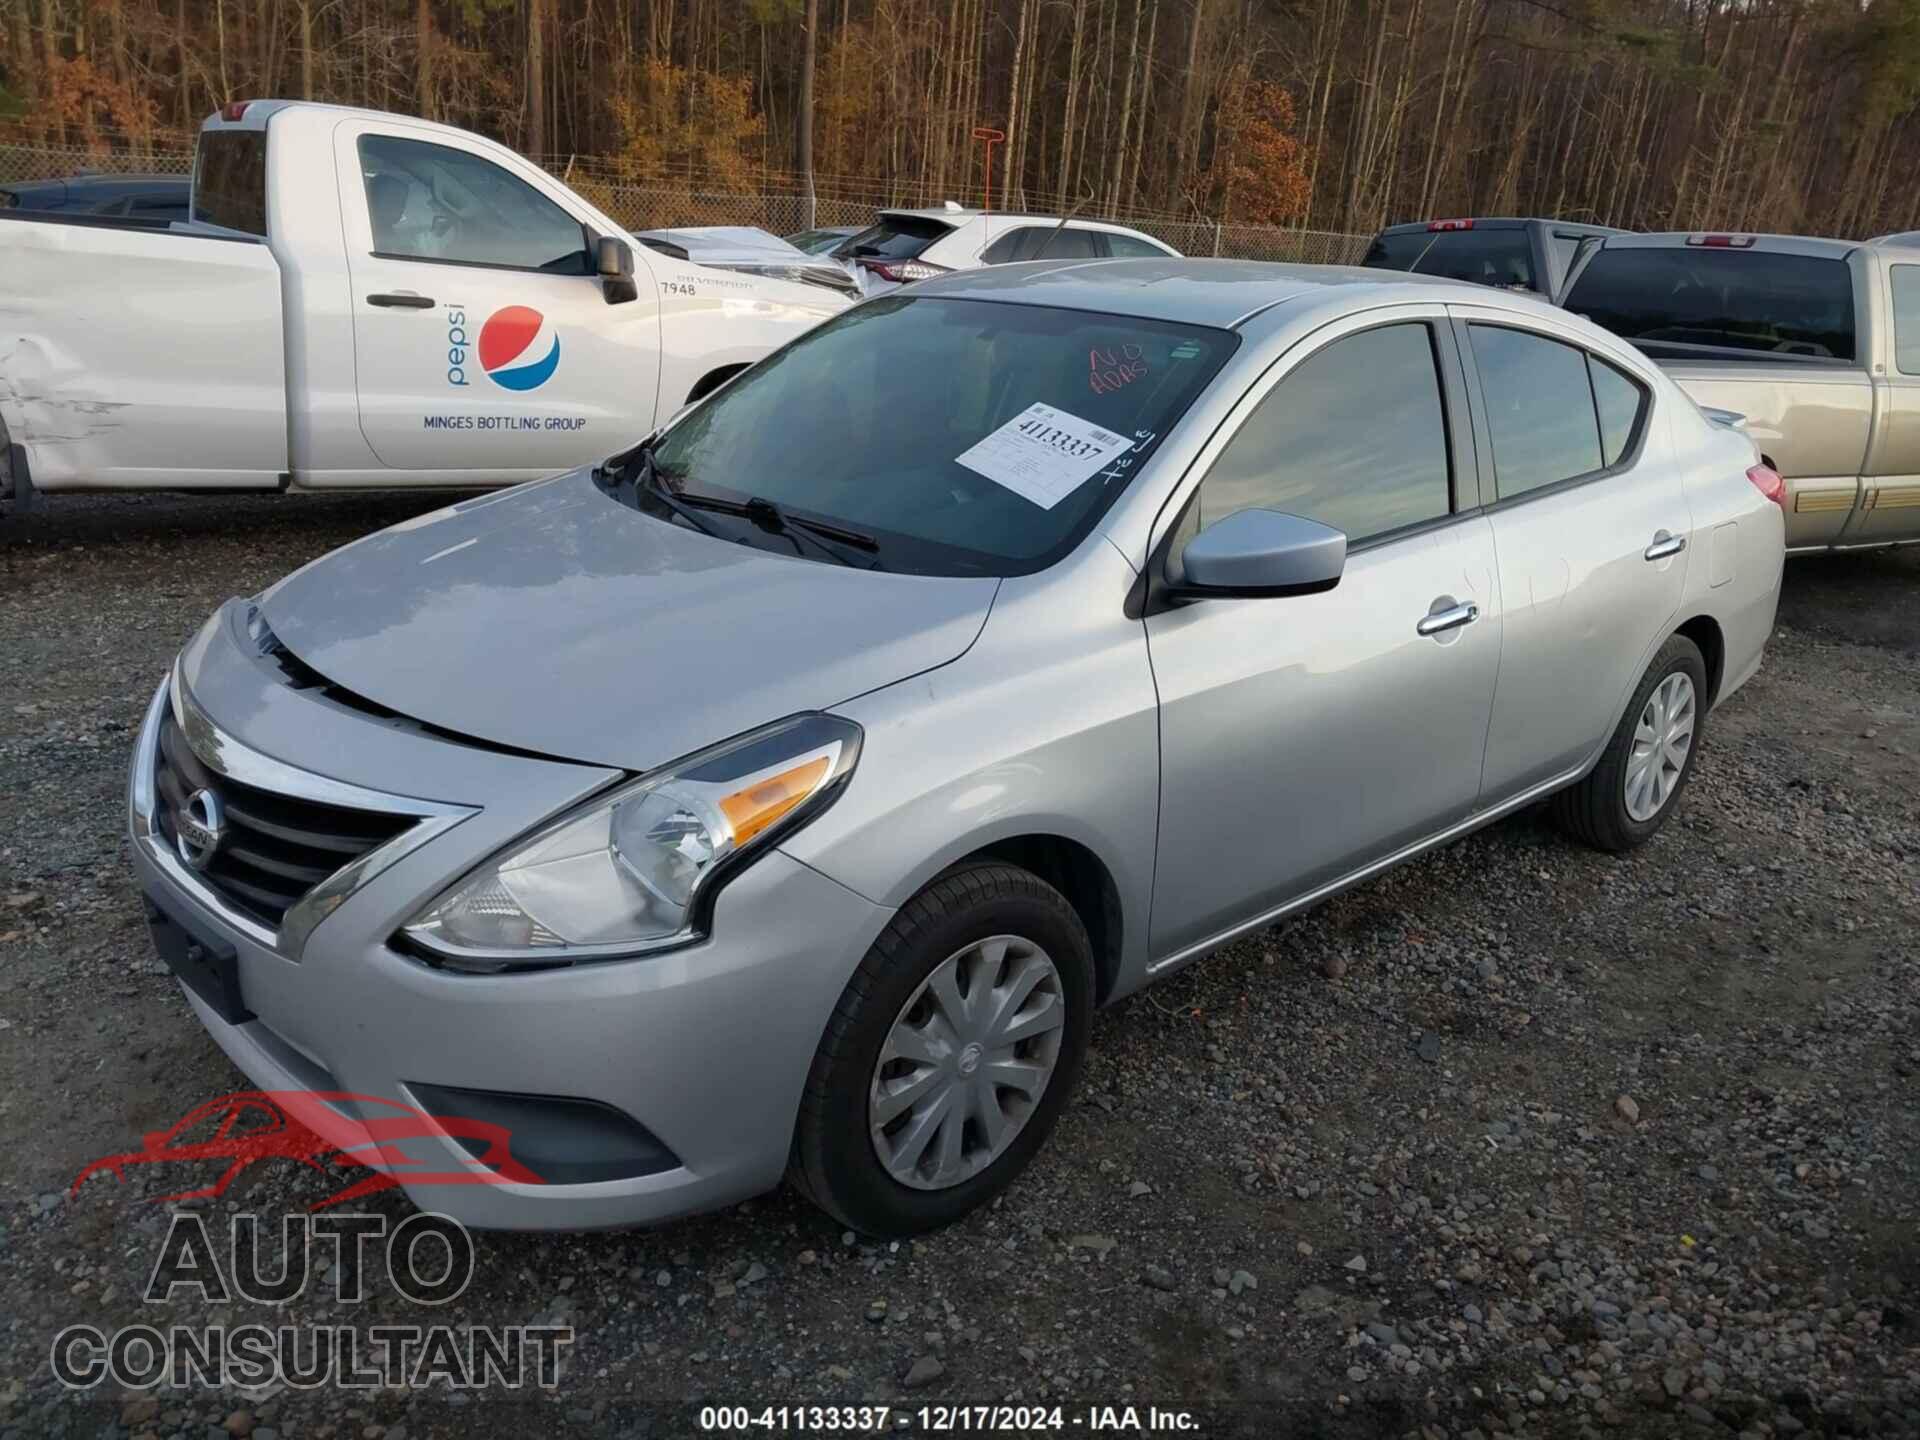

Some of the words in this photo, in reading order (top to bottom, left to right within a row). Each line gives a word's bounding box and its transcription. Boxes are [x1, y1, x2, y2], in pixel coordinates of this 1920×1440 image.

[660, 281, 697, 297] 7948
[444, 303, 471, 386] pepsi
[424, 416, 474, 429] MINGES
[477, 416, 541, 430] BOTTLING
[544, 417, 587, 431] GROUP
[1019, 419, 1104, 461] 41133337
